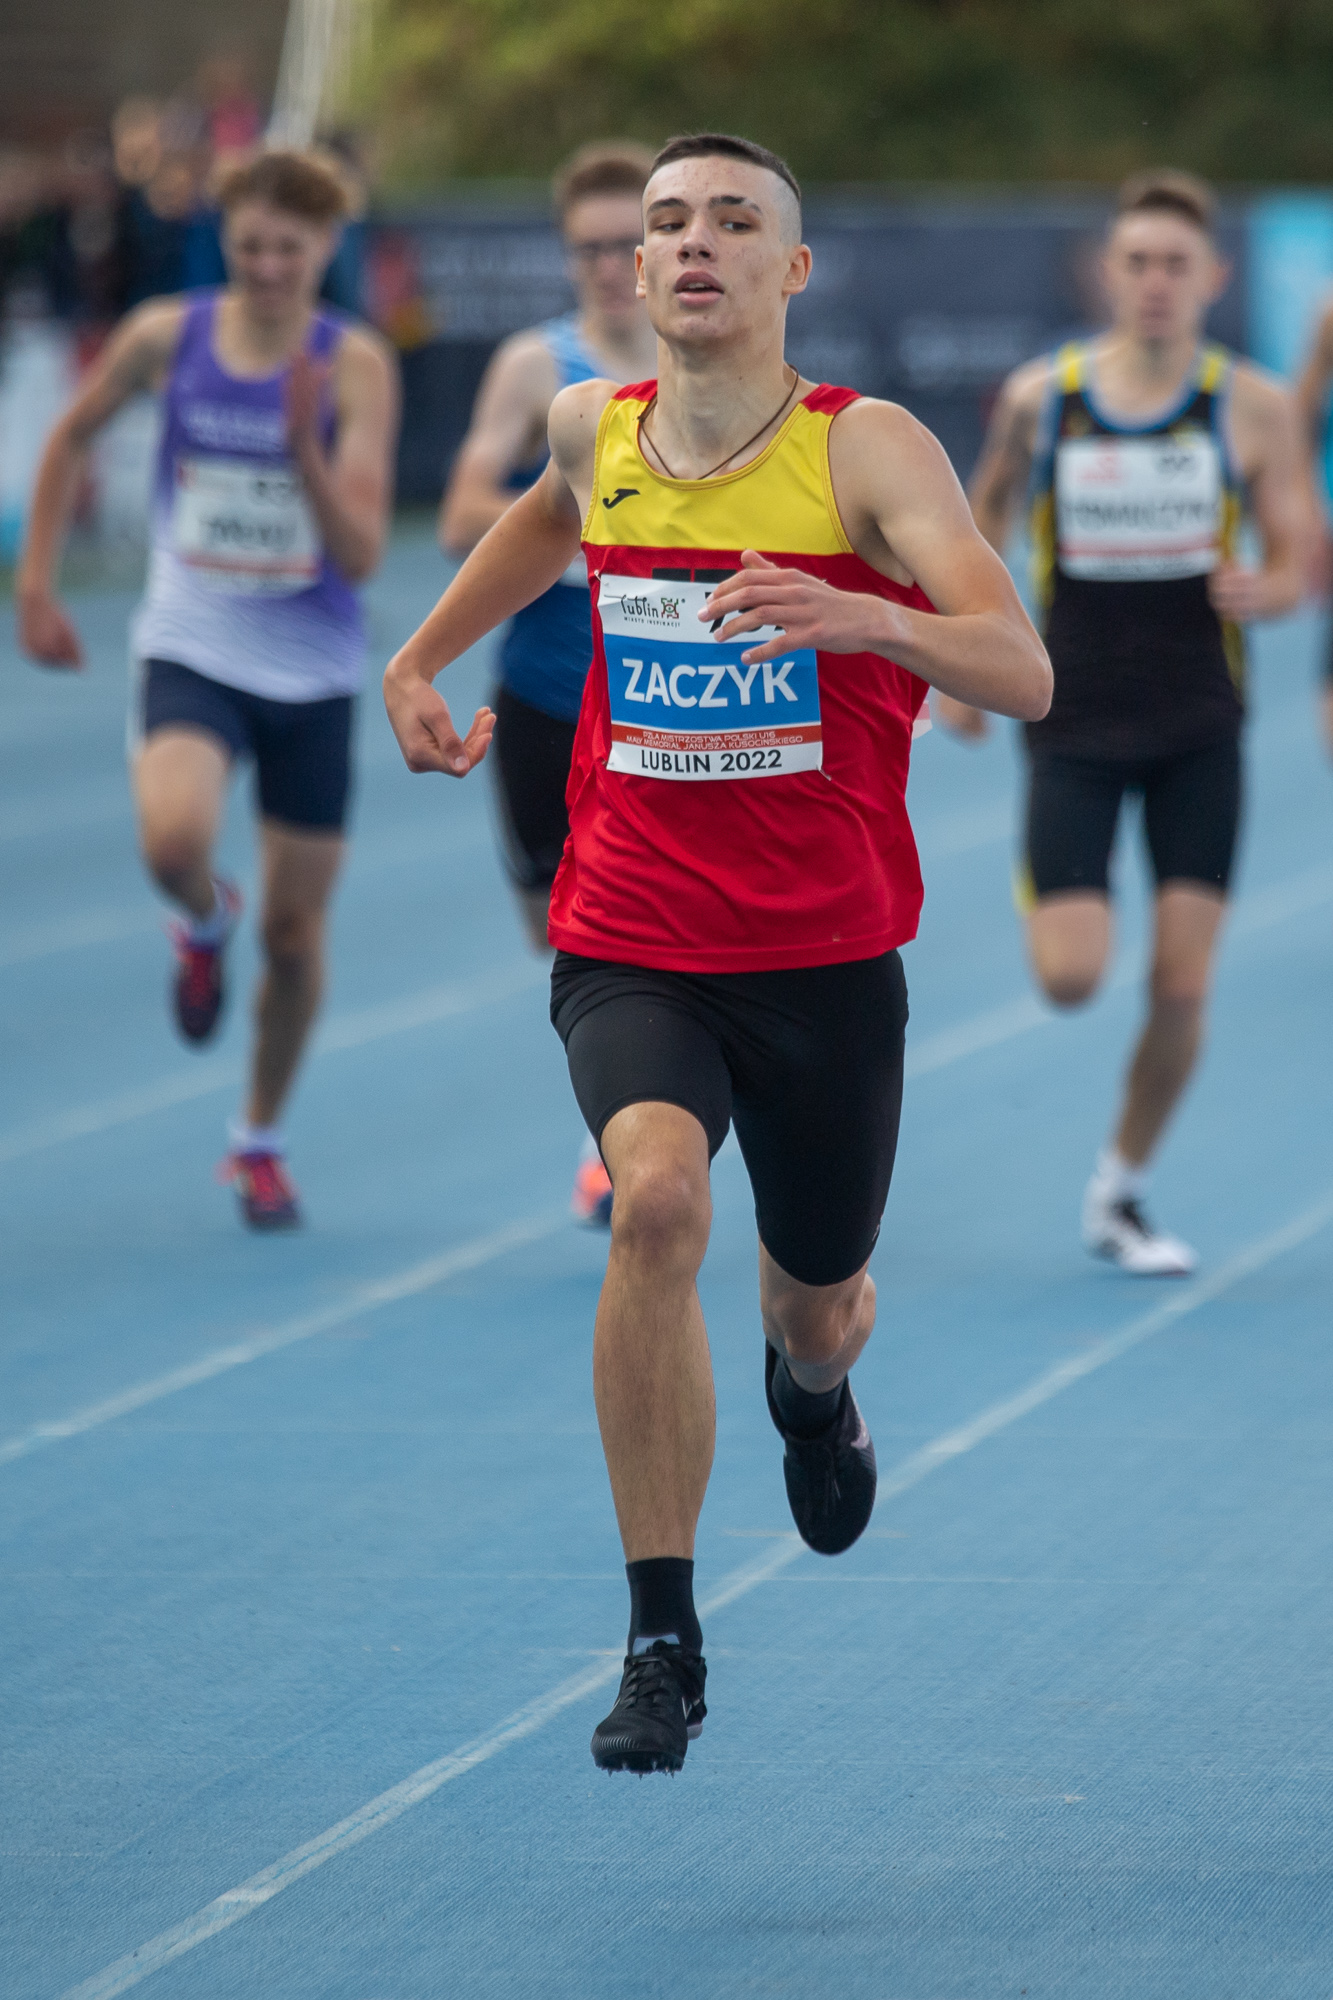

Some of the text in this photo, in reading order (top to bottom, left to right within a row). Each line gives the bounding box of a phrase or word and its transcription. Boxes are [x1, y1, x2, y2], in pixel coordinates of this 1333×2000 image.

[623, 616, 681, 629] MIASTO INSPIRACJI
[621, 657, 799, 709] ZACZYK
[642, 731, 776, 744] PZLA MISTRZOSTWA POLSKI U16
[683, 741, 727, 751] JANUSZA
[641, 749, 782, 773] LUBLIN 2022
